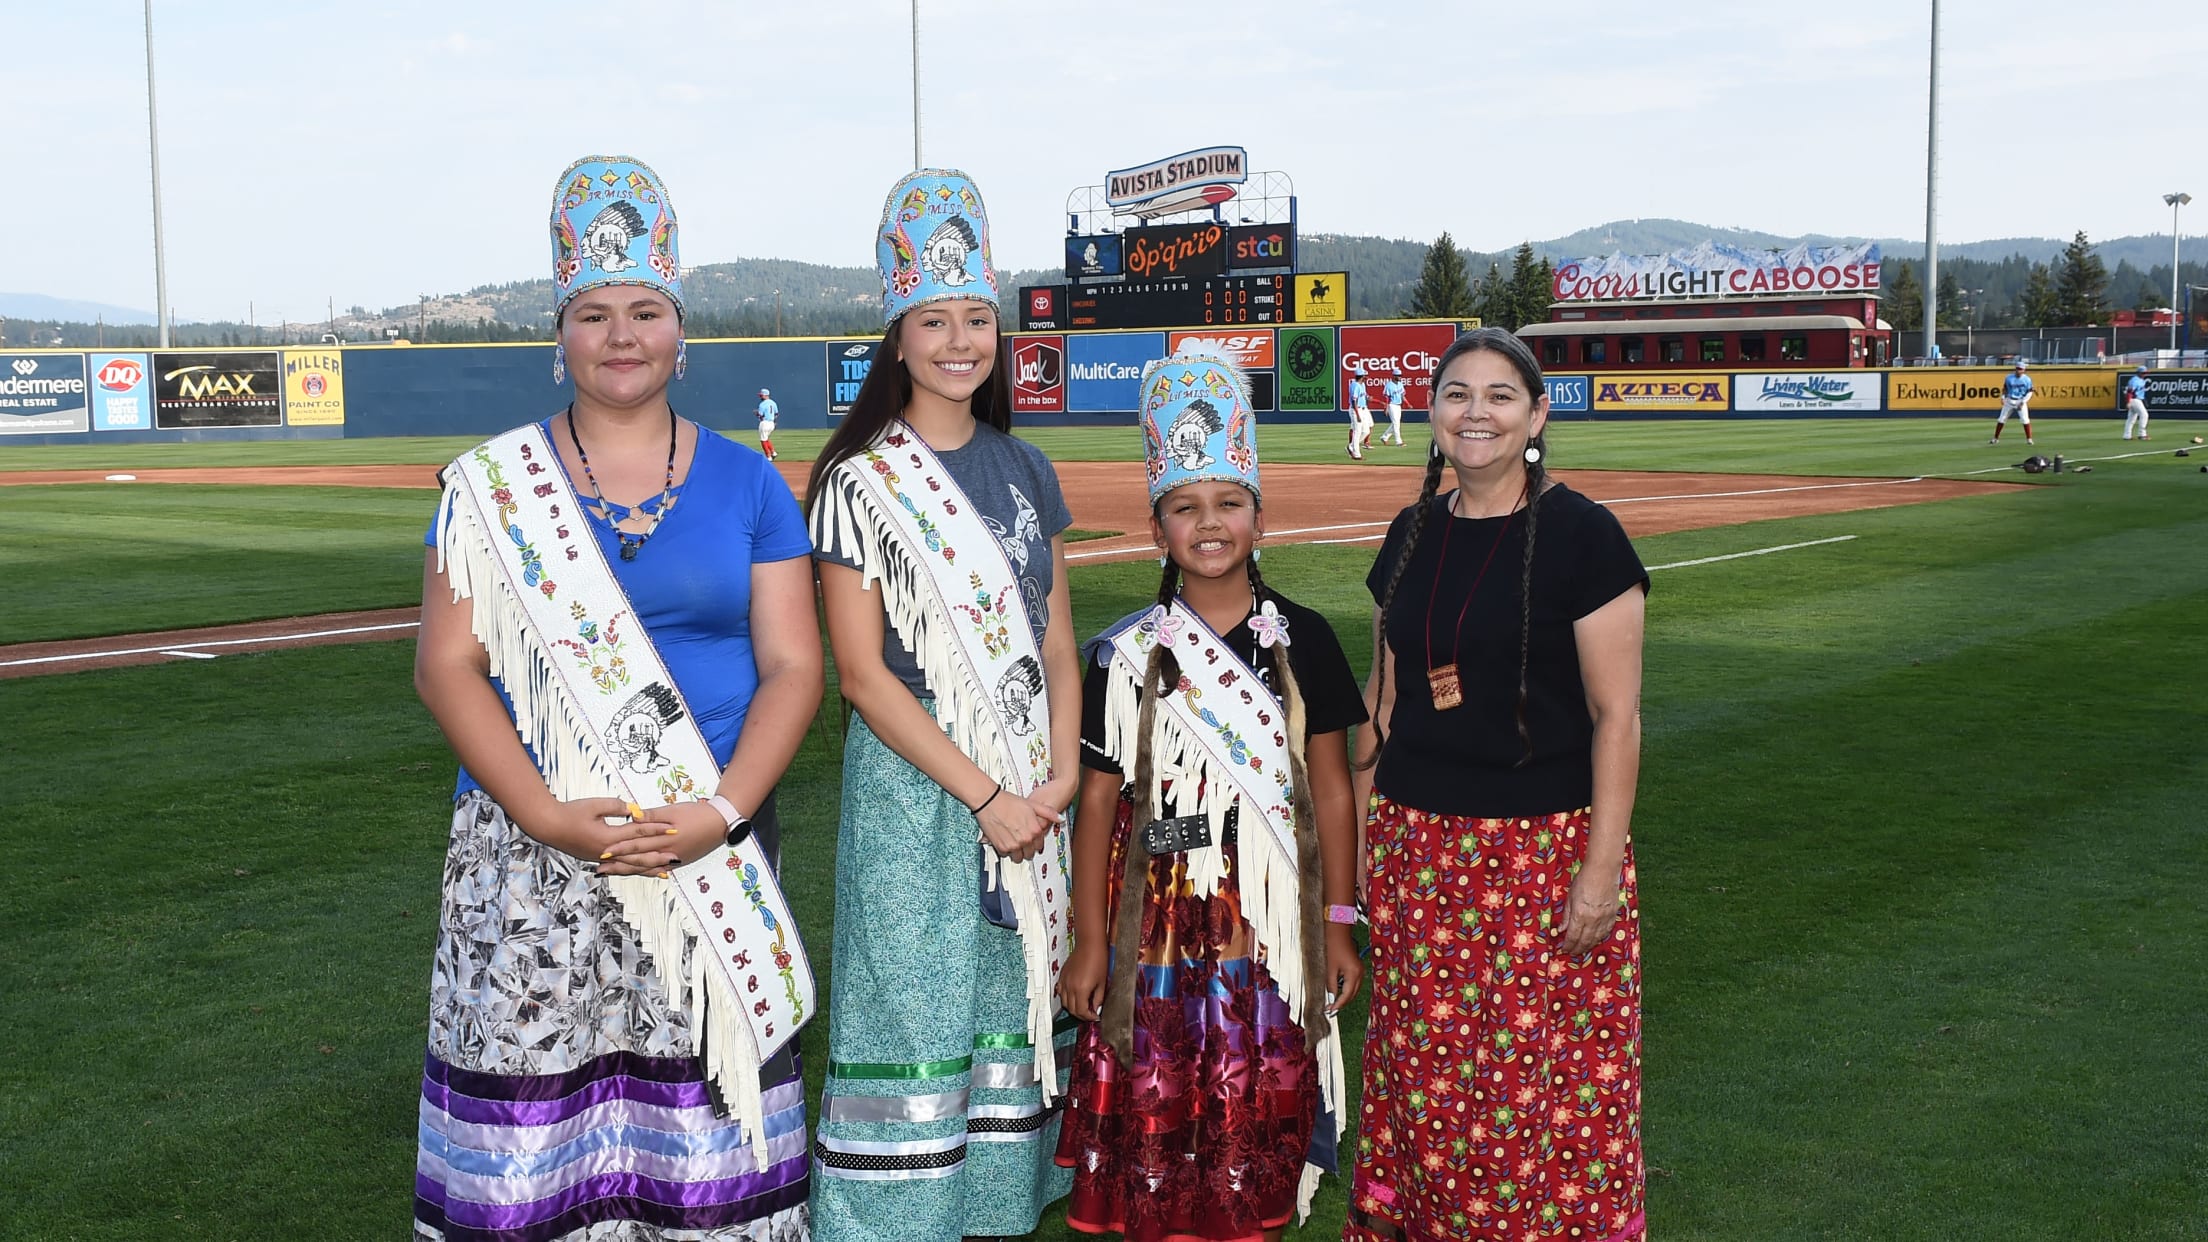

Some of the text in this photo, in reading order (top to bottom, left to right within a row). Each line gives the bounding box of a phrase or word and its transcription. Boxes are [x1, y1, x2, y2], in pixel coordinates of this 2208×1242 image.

[1110, 154, 1242, 198] AVISTA STADIUM
[604, 189, 634, 200] MISS
[928, 203, 963, 216] MISS
[1236, 234, 1283, 259] stcu
[1110, 286, 1115, 294] 2
[1145, 284, 1150, 292] 6
[1172, 283, 1177, 291] 9
[1256, 275, 1283, 289] BALL 0
[1552, 264, 1881, 300] Coors LIGHT CABOOSE
[1205, 290, 1246, 305] 0 0 0
[1254, 292, 1283, 305] STRIKE 0
[1205, 308, 1246, 323] 0 0 0
[1275, 308, 1283, 322] 0
[1305, 307, 1336, 316] CASINO
[1028, 321, 1056, 329] TOYOTA
[1462, 322, 1477, 331] 356
[286, 355, 341, 378] MILLER
[1016, 350, 1059, 385] Jack
[1342, 351, 1441, 375] Great Clip
[105, 366, 137, 385] DQ
[1070, 362, 1140, 380] MultiCare
[179, 373, 257, 401] MAX
[1290, 386, 1327, 396] DEPT OF
[1596, 382, 1725, 403] AZTECA
[1762, 376, 1850, 396] Living Water
[1896, 382, 1958, 400] Edward
[1959, 382, 2001, 401] Jone
[2145, 378, 2200, 394] Complete
[23, 398, 58, 407] ESTATE
[1018, 396, 1057, 404] in the box
[1281, 395, 1334, 405] IMAGINATION
[1804, 400, 1817, 408] Tree
[2151, 395, 2168, 405] and
[2168, 395, 2193, 405] Sheet
[107, 415, 139, 425] GOOD
